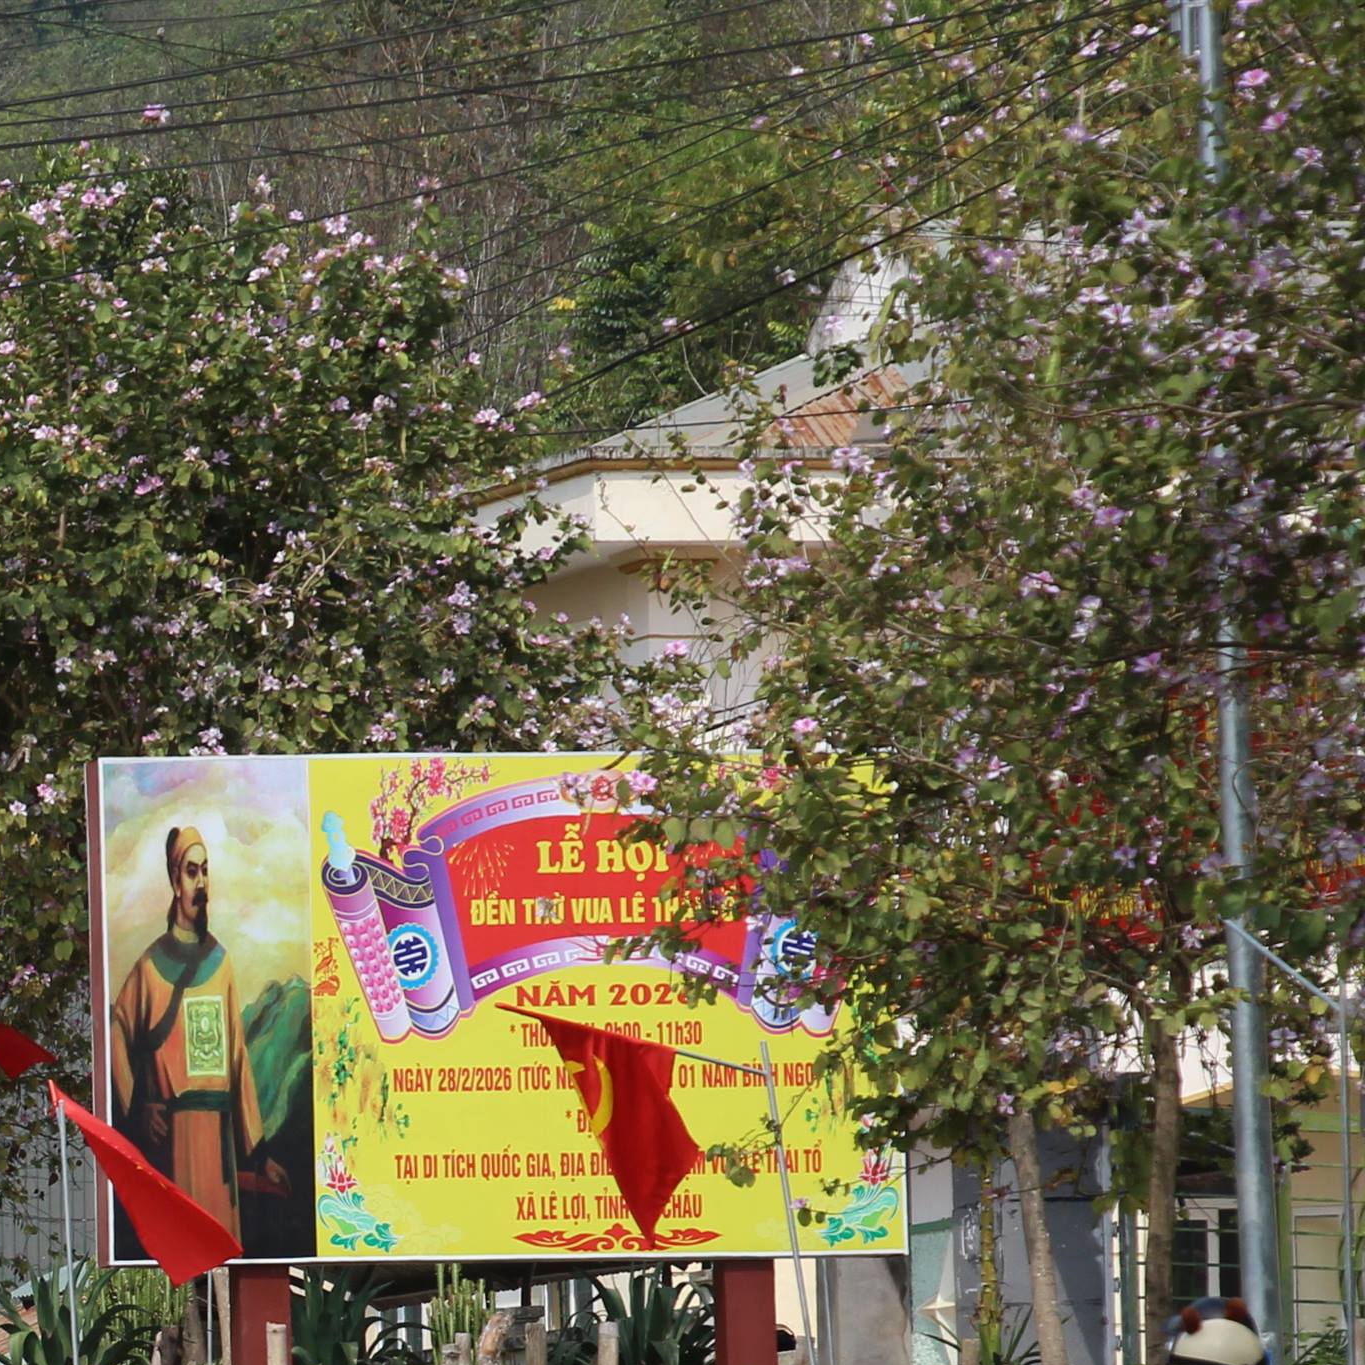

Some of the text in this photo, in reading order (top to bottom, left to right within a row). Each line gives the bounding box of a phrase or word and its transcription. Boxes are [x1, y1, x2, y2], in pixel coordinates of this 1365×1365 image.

[536, 823, 586, 874] LỄ
[471, 891, 517, 926] ĐỀN
[571, 897, 614, 924] VUA
[621, 892, 646, 923] LÊ
[516, 981, 596, 1007] NĂM
[656, 1020, 702, 1045] 11h30
[393, 1063, 433, 1092] NGÀY
[438, 1066, 512, 1091] 28/2/2026
[518, 1061, 551, 1093] (TỨC
[678, 1064, 695, 1088] 01
[395, 1154, 418, 1184] TẠI
[423, 1154, 437, 1178] DI
[443, 1149, 476, 1178] TÍCH
[481, 1144, 520, 1180] QUỐC
[527, 1153, 556, 1179] GIA,
[560, 1152, 586, 1182] ĐỊA
[803, 1139, 822, 1173] TỔ
[516, 1191, 536, 1220] XÃ
[541, 1191, 557, 1220] LÊ
[563, 1193, 591, 1226] LỢI,
[595, 1187, 629, 1219] TỈNH
